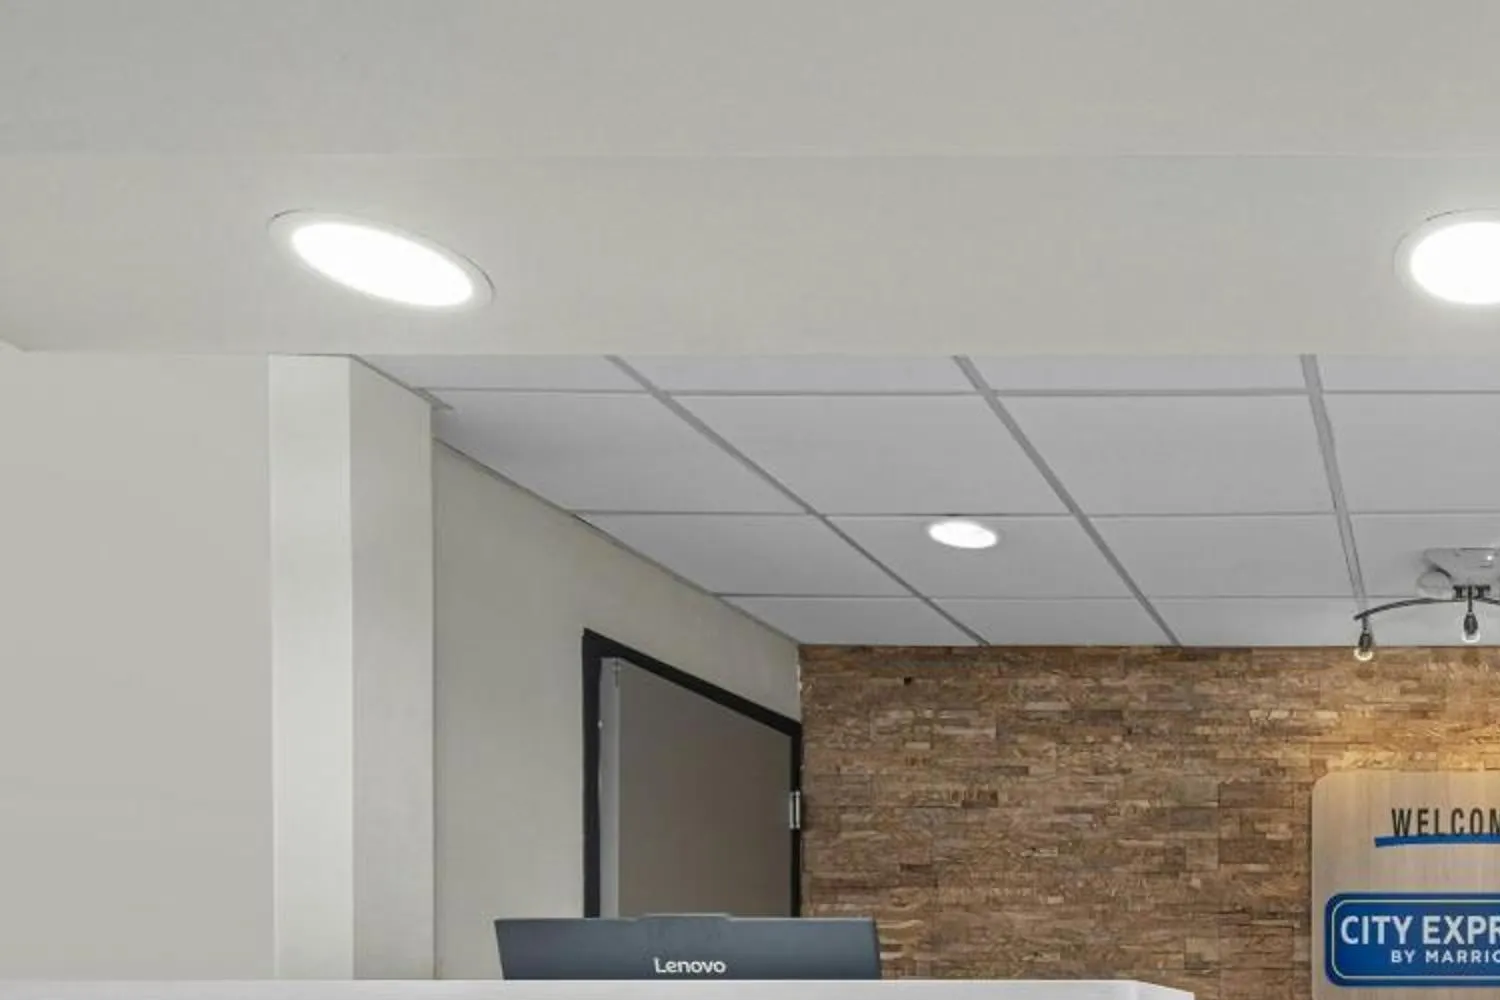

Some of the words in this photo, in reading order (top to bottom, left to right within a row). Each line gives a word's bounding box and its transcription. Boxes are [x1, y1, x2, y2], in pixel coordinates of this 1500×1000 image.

[1340, 915, 1413, 945] CITY
[653, 957, 726, 974] Lenovo
[1391, 950, 1415, 964] BY
